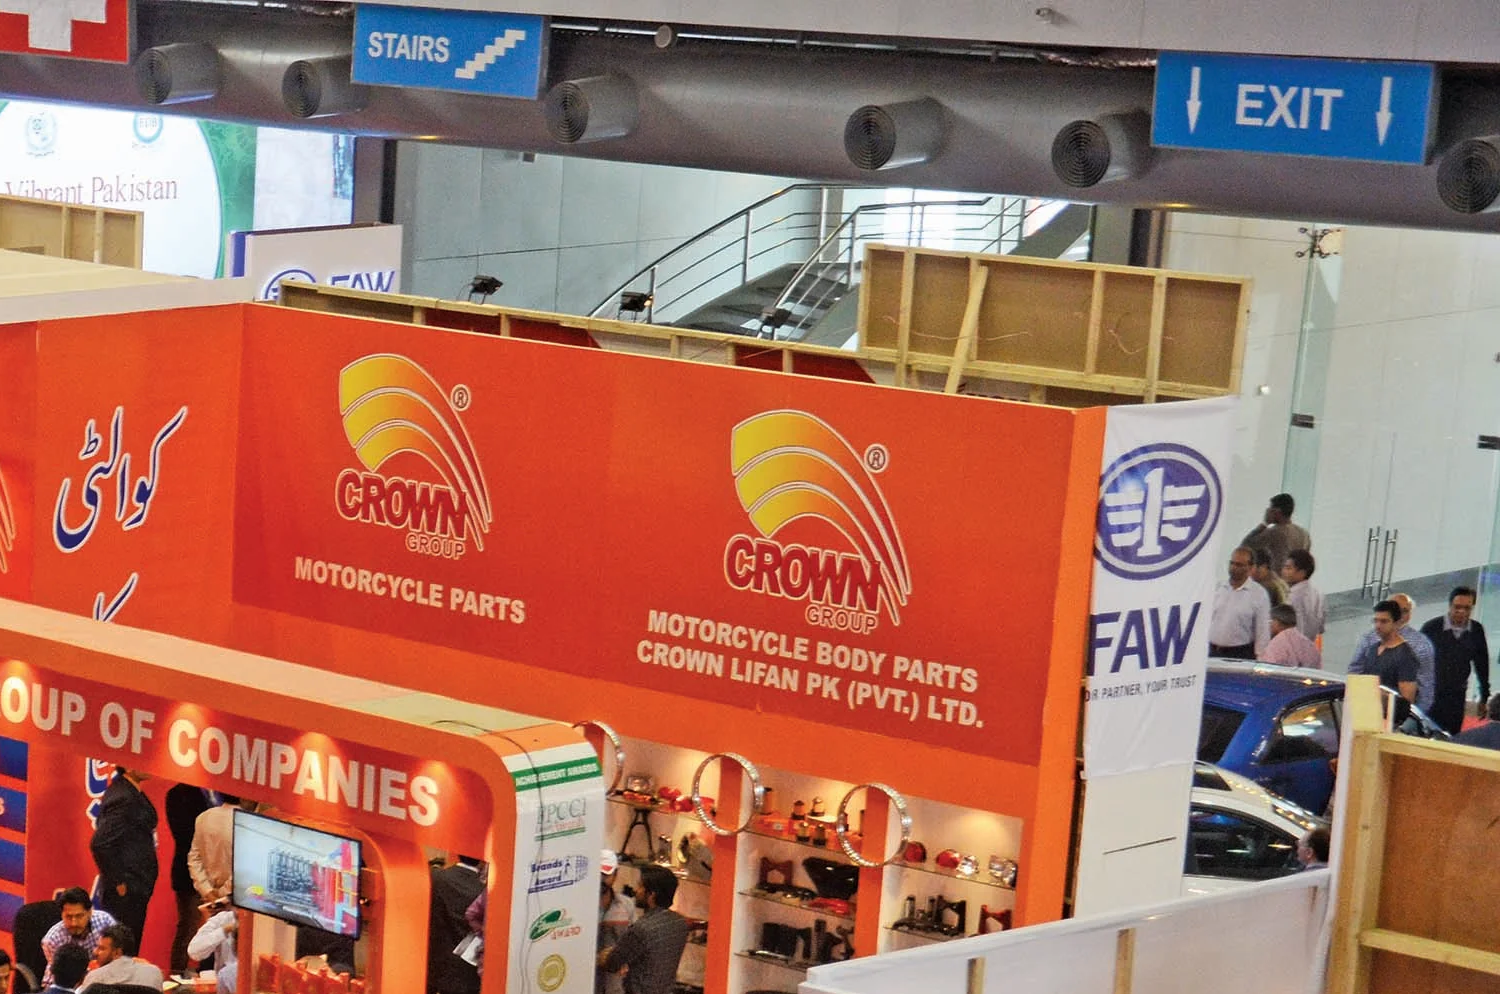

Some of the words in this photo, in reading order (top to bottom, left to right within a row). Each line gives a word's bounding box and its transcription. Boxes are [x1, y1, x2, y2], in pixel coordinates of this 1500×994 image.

[367, 32, 451, 64] STAIRS
[1235, 82, 1344, 131] EXIT
[5, 180, 84, 205] Vibrant
[90, 174, 178, 204] Pakistan
[335, 468, 470, 541] CROWN
[405, 532, 467, 561] GROUP
[724, 533, 886, 614] CROWN
[294, 555, 444, 609] MOTORCYCLE
[450, 587, 527, 625] PARTS
[804, 604, 879, 636] GROUP
[647, 609, 809, 663] MOTORCYCLE
[815, 641, 887, 676] BODY
[893, 655, 979, 693] PARTS
[1087, 601, 1202, 677] FAW
[636, 639, 724, 678] CROWN
[730, 657, 799, 692] LIFAN
[806, 673, 841, 700] PK
[847, 680, 920, 722] (PVT.)
[928, 695, 984, 728] LTD.
[100, 702, 155, 754] OF
[168, 718, 440, 827] COMPANIES
